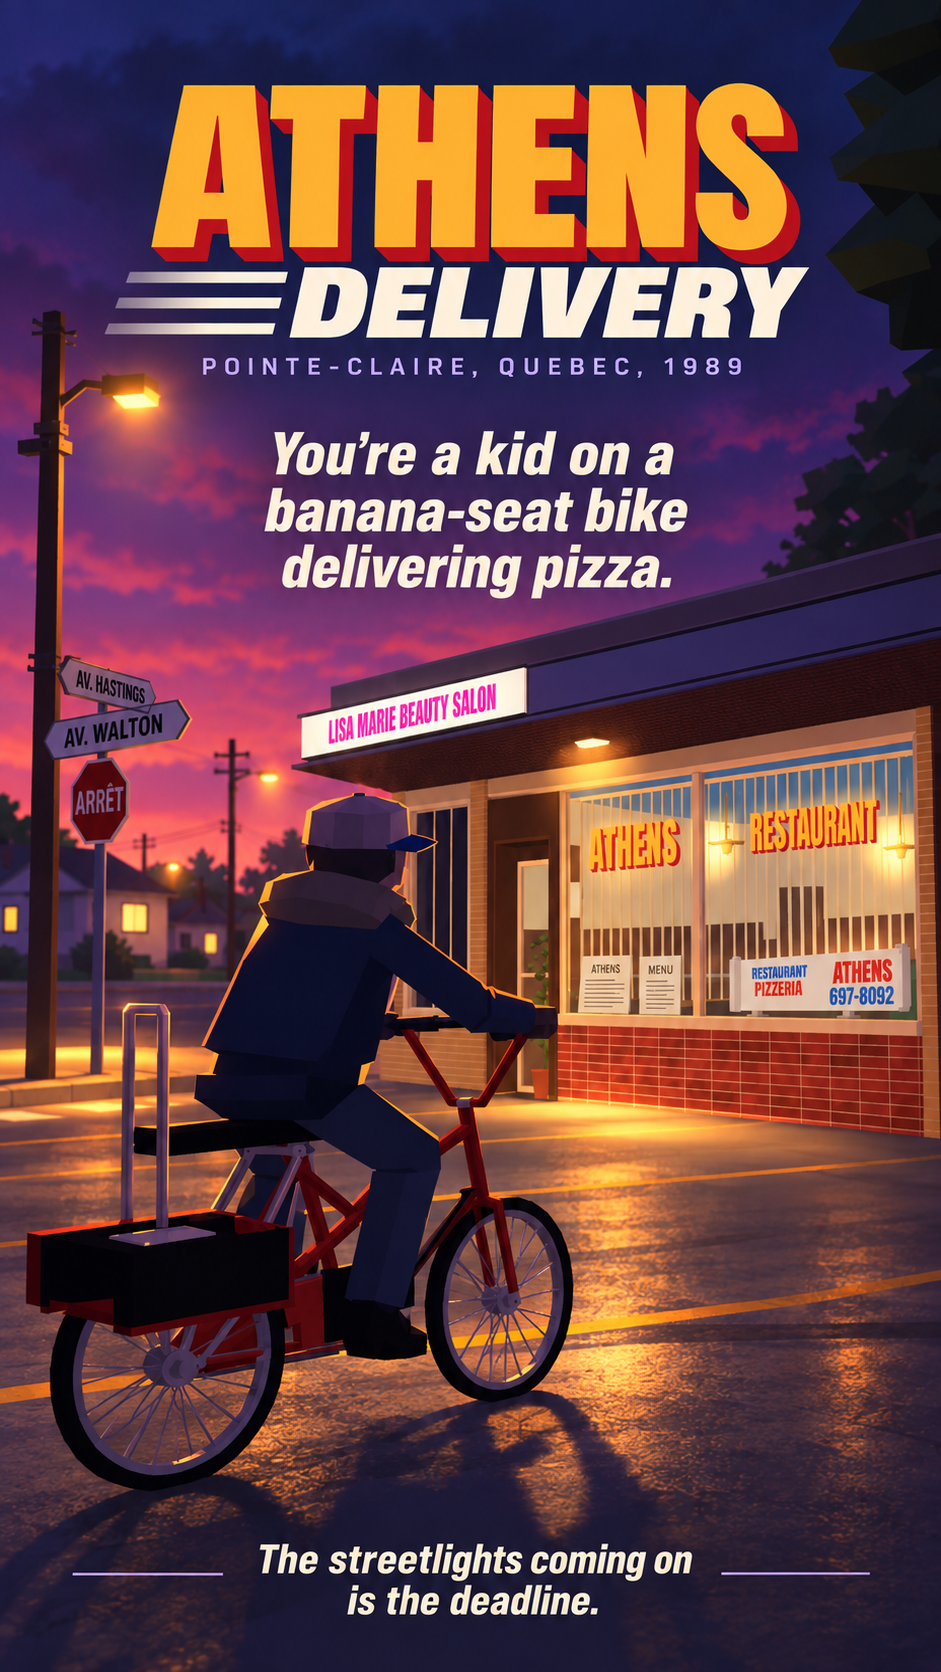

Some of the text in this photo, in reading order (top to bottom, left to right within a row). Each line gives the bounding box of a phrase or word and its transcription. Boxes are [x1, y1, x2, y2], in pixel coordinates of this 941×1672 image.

[76, 670, 145, 704] AV. HASTINGS
[328, 683, 497, 744] LISA MARIE BEAUTY SALON
[64, 713, 163, 748] AV. WALTON
[75, 782, 124, 815] ARRÊT
[750, 800, 880, 855] RESTAURANT
[589, 818, 680, 873] ATHENS
[591, 963, 621, 974] ATHENS
[648, 964, 673, 975] MENU
[751, 964, 808, 980] RESTAURANT
[832, 958, 893, 984] ATHENS
[754, 980, 803, 997] PIZZERIA
[829, 986, 895, 1006] 697-8092
